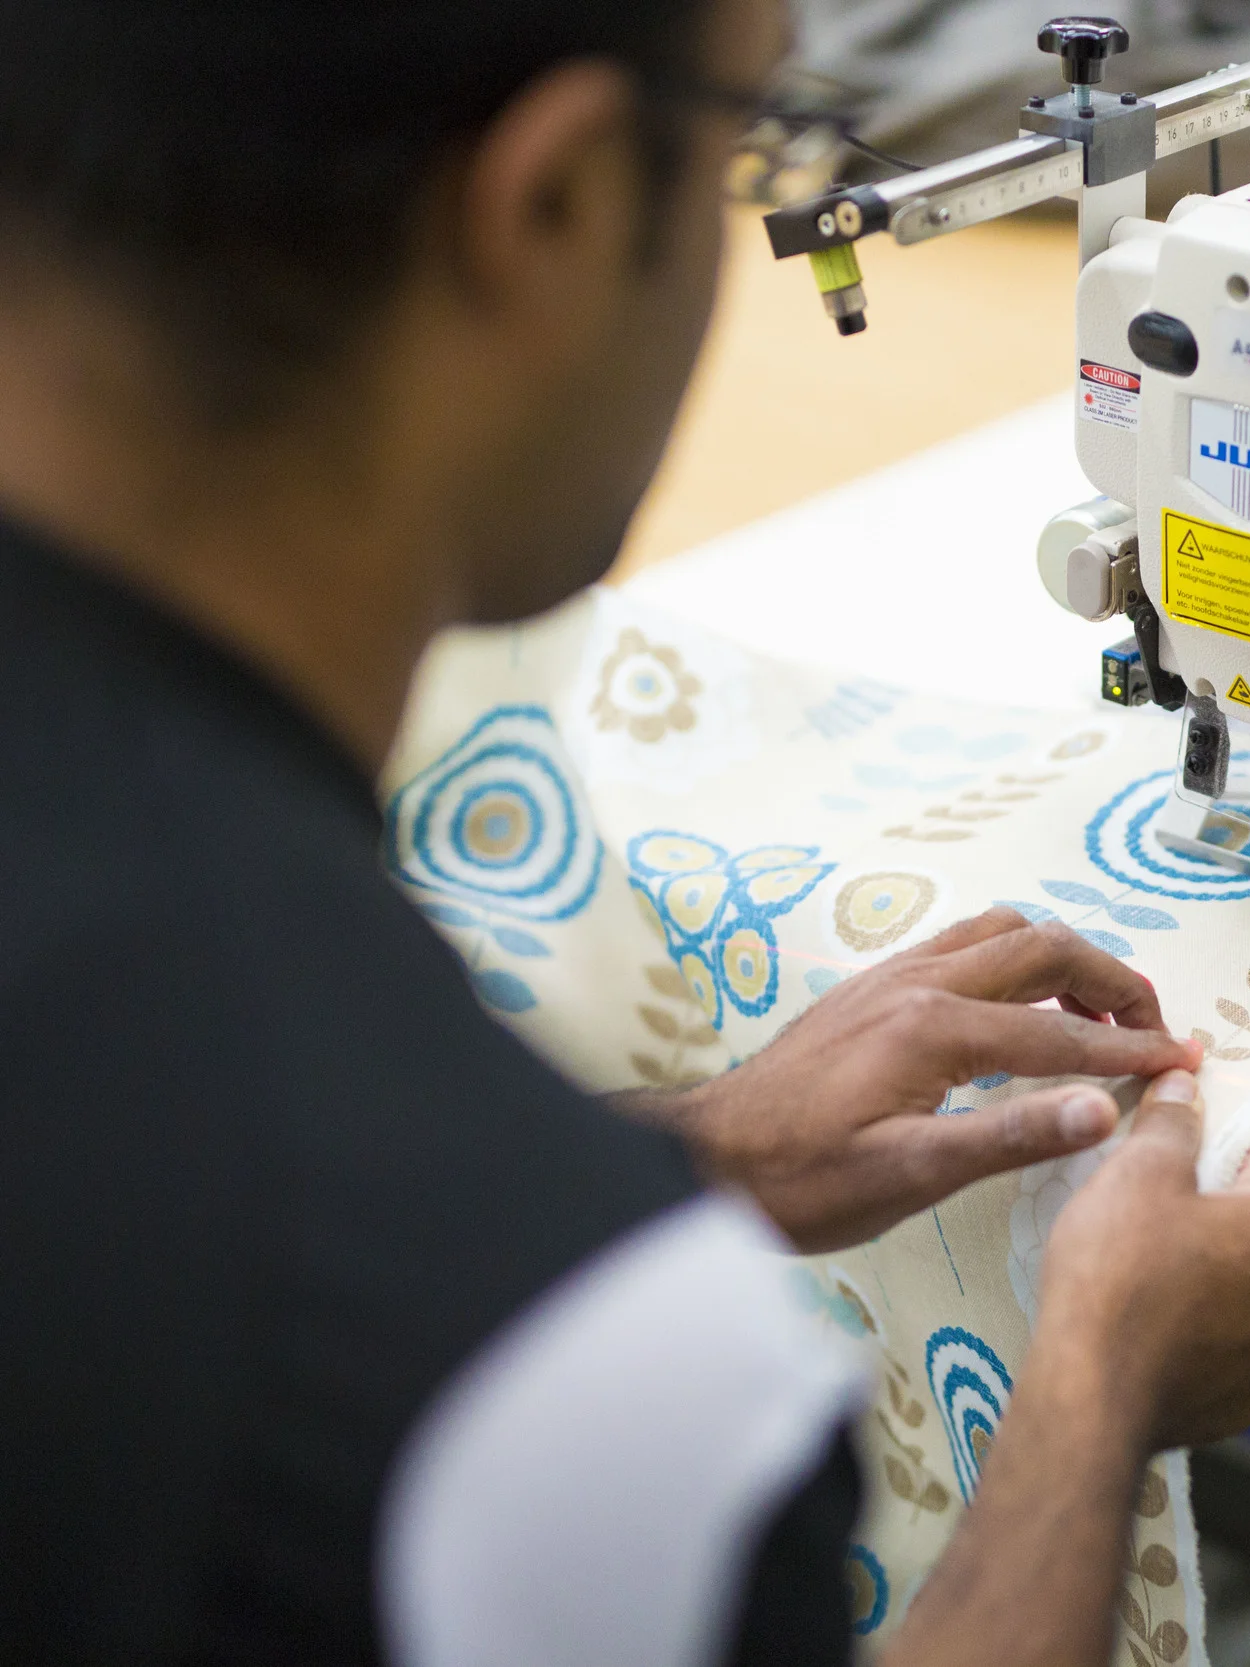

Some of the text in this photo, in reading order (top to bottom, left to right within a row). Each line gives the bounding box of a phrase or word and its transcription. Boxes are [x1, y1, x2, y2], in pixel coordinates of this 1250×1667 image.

[1060, 166, 1069, 178] 10
[1168, 128, 1177, 141] 16
[1185, 122, 1195, 135] 17
[1202, 116, 1212, 129] 18
[1220, 110, 1229, 122] 19
[1235, 104, 1245, 118] 20
[1092, 367, 1129, 387] CAUTION
[1176, 559, 1190, 570] Niet
[1192, 564, 1216, 577] zonder
[1176, 589, 1193, 601] Voor
[1176, 600, 1190, 609] etc.
[1191, 602, 1250, 627] hoofdschakelaar
